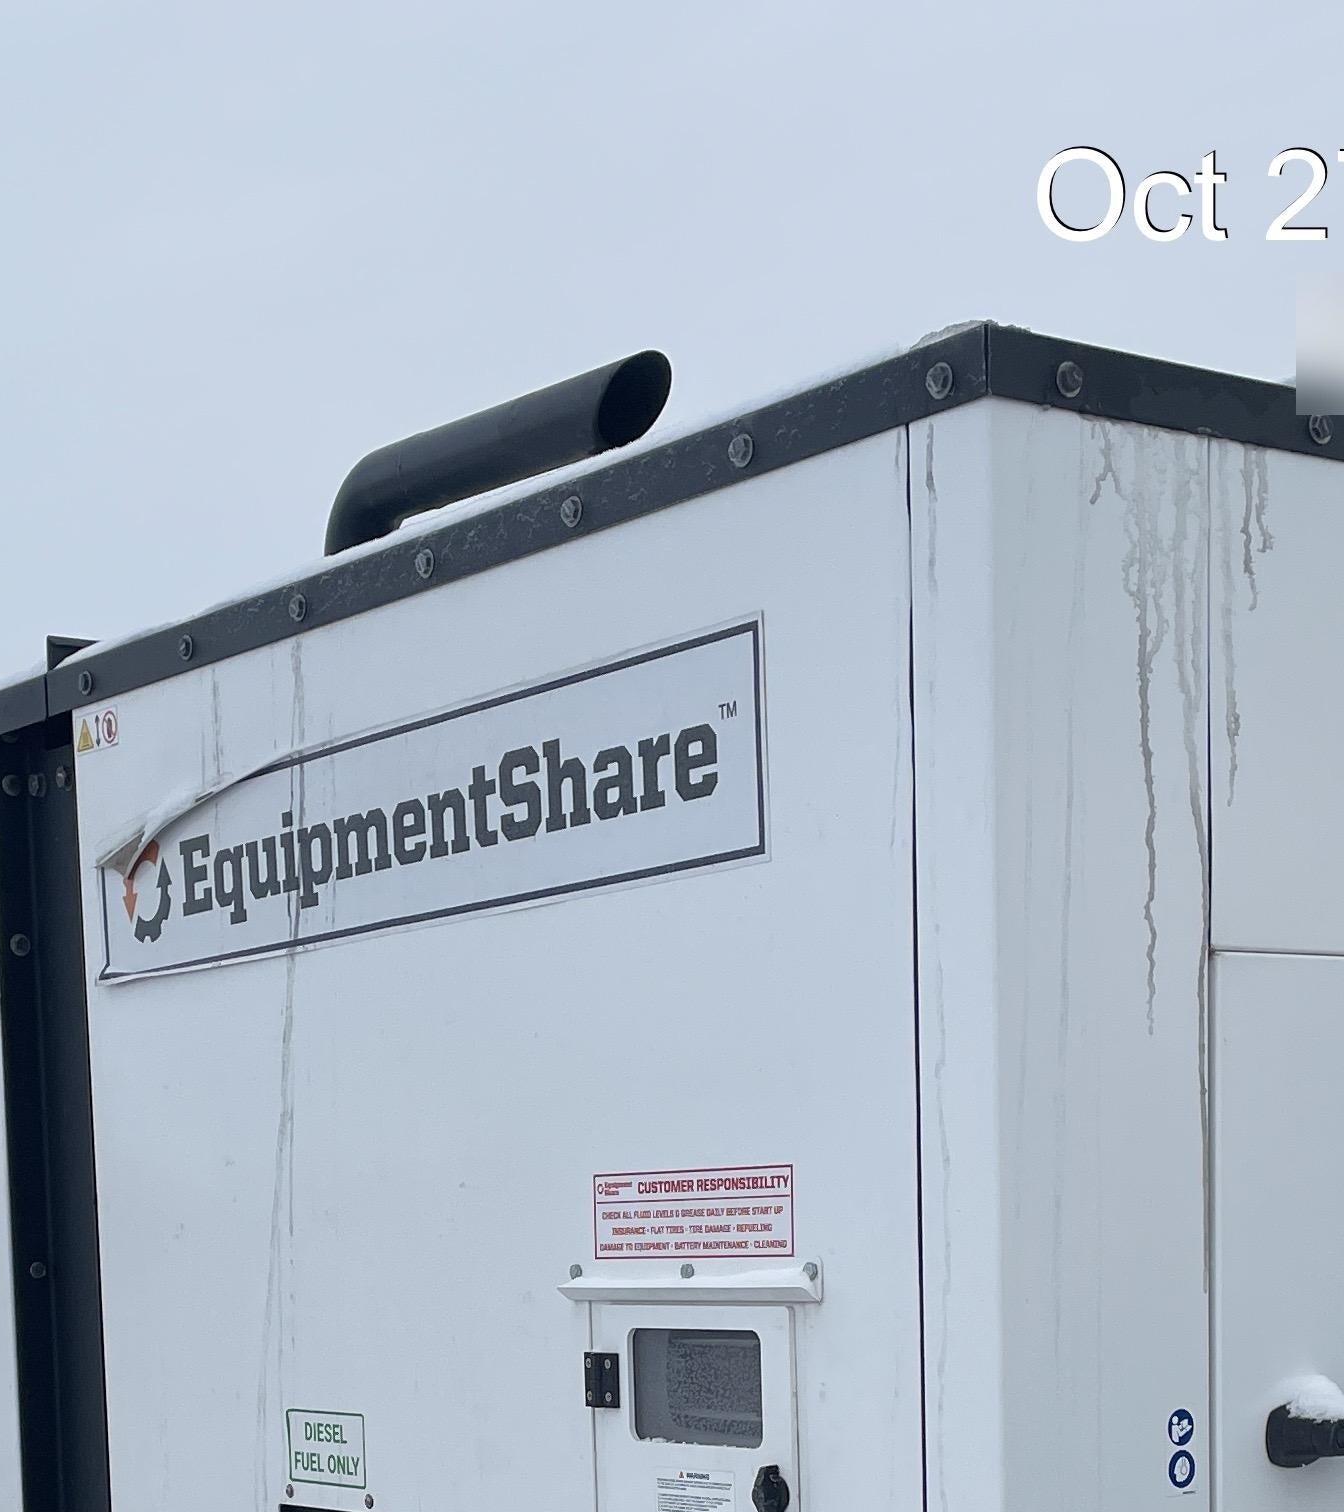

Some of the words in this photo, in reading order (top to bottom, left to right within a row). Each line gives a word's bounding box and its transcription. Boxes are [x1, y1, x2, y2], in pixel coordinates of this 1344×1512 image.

[179, 722, 719, 925] EquipmentShare
[637, 1180, 695, 1194] CUSTOMER
[696, 1174, 790, 1192] RESPONSIBILITY
[601, 1211, 622, 1220] CHECK
[622, 1210, 633, 1219] ALL
[652, 1209, 675, 1219] LEVELS
[706, 1207, 725, 1217] DAILY
[751, 1205, 773, 1216] START
[773, 1205, 784, 1215] UP
[650, 1226, 665, 1235] FLAT
[625, 1242, 634, 1251] TO
[304, 1421, 348, 1444] DIESEL
[294, 1450, 325, 1473] FUEL
[327, 1453, 360, 1477] ONLY
